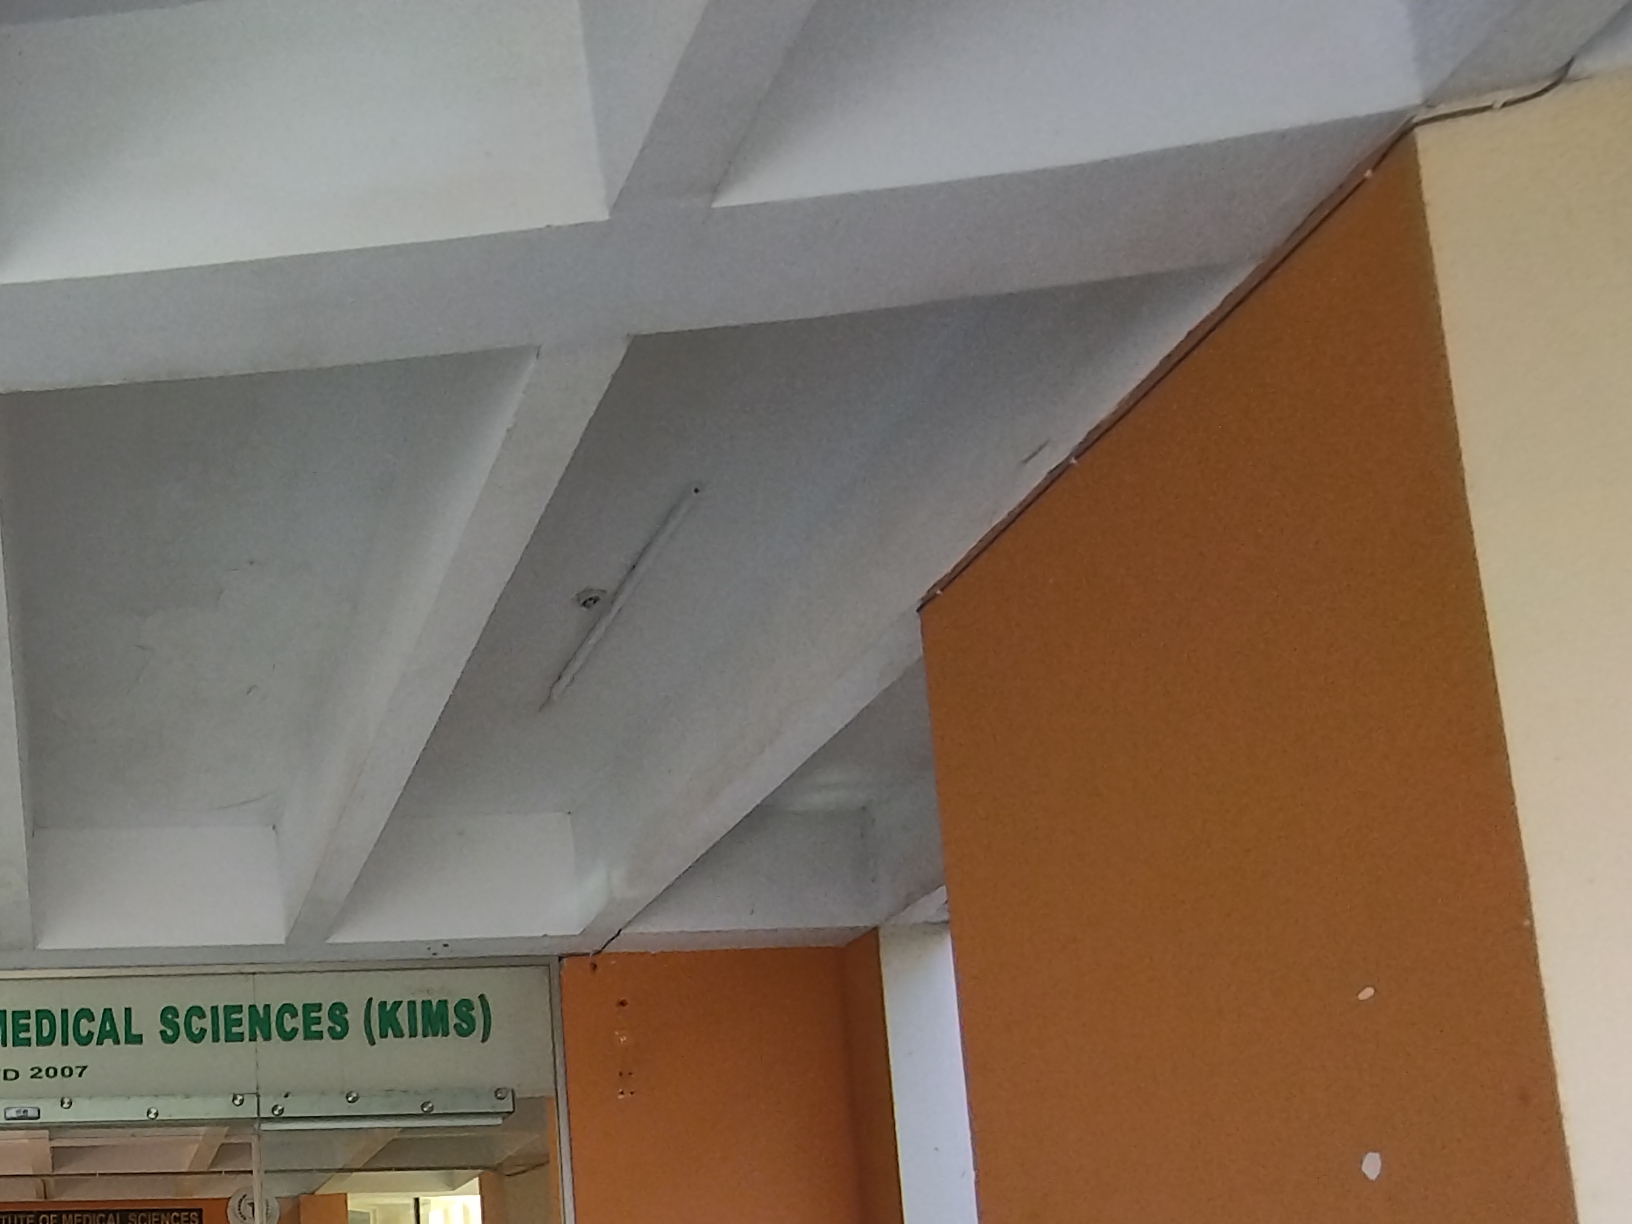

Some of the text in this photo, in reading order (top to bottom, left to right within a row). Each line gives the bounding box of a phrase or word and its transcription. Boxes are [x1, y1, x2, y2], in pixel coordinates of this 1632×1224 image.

[159, 1001, 350, 1045] SCIENCES
[363, 994, 493, 1045] (KIMS)
[29, 1065, 88, 1080] 2007
